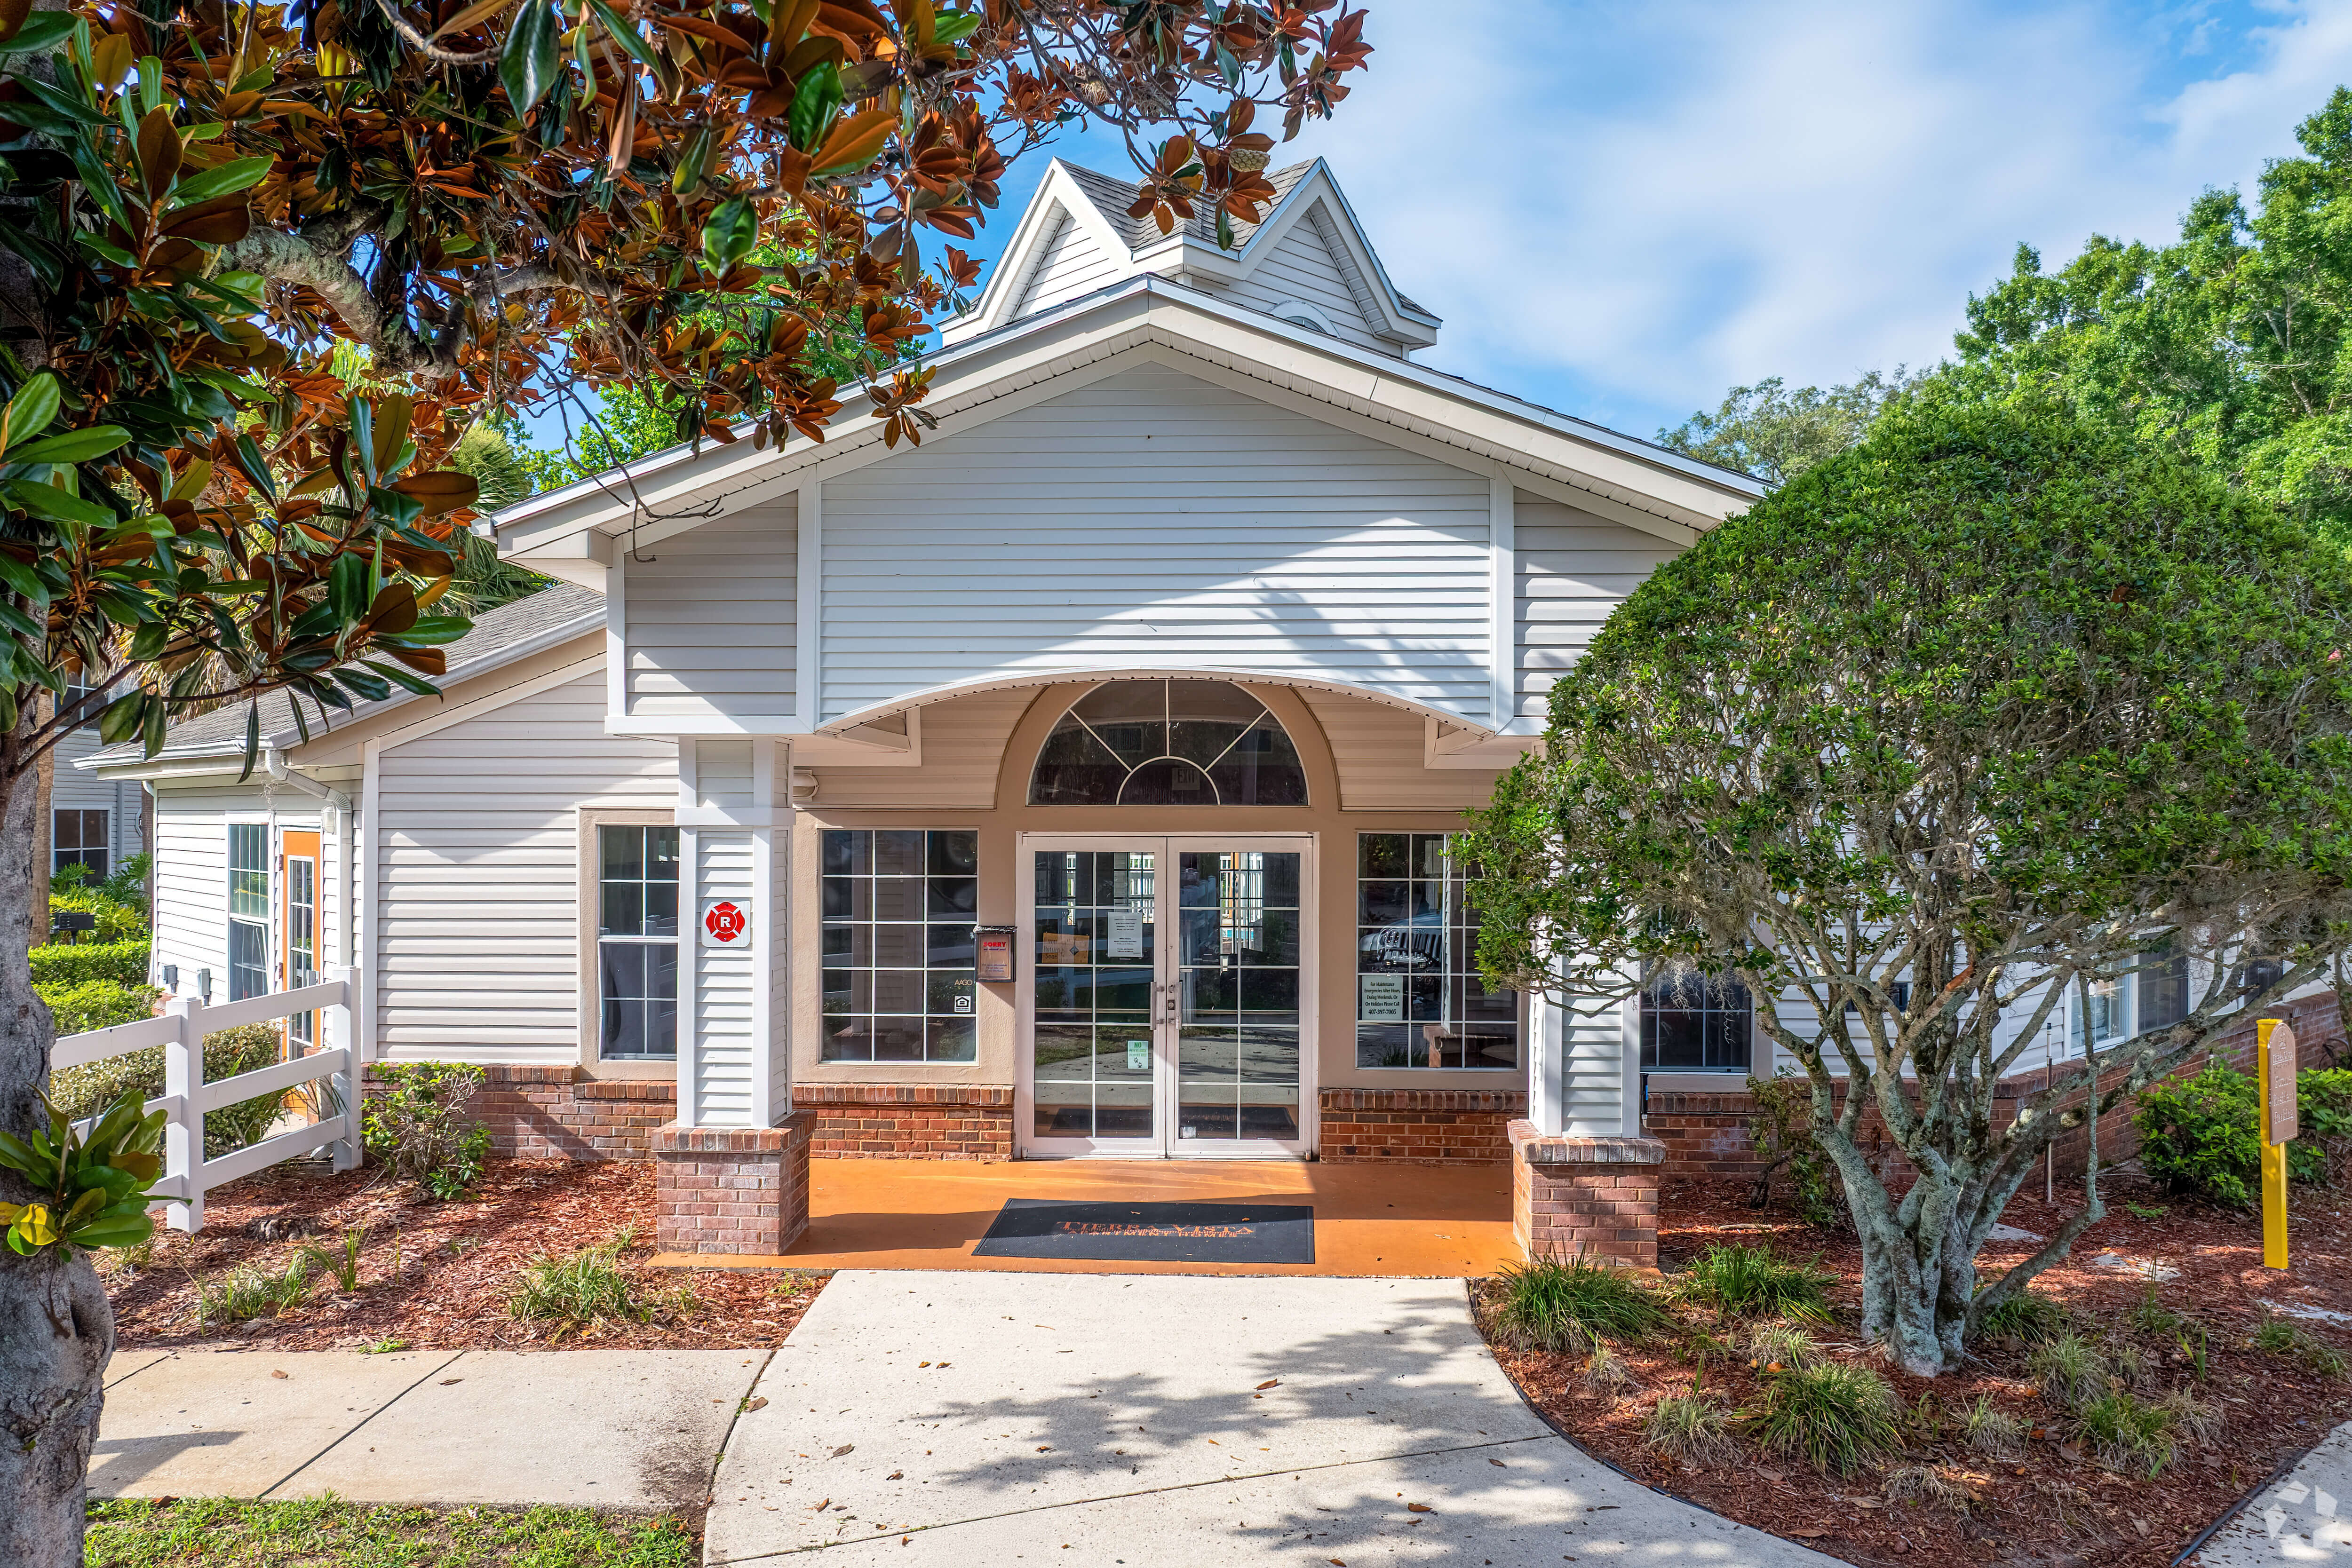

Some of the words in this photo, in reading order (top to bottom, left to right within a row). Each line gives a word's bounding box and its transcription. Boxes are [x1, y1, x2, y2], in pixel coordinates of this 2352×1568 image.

[1177, 769, 1195, 783] EXIT
[720, 917, 731, 927] R
[1172, 1224, 1254, 1234] VISTA
